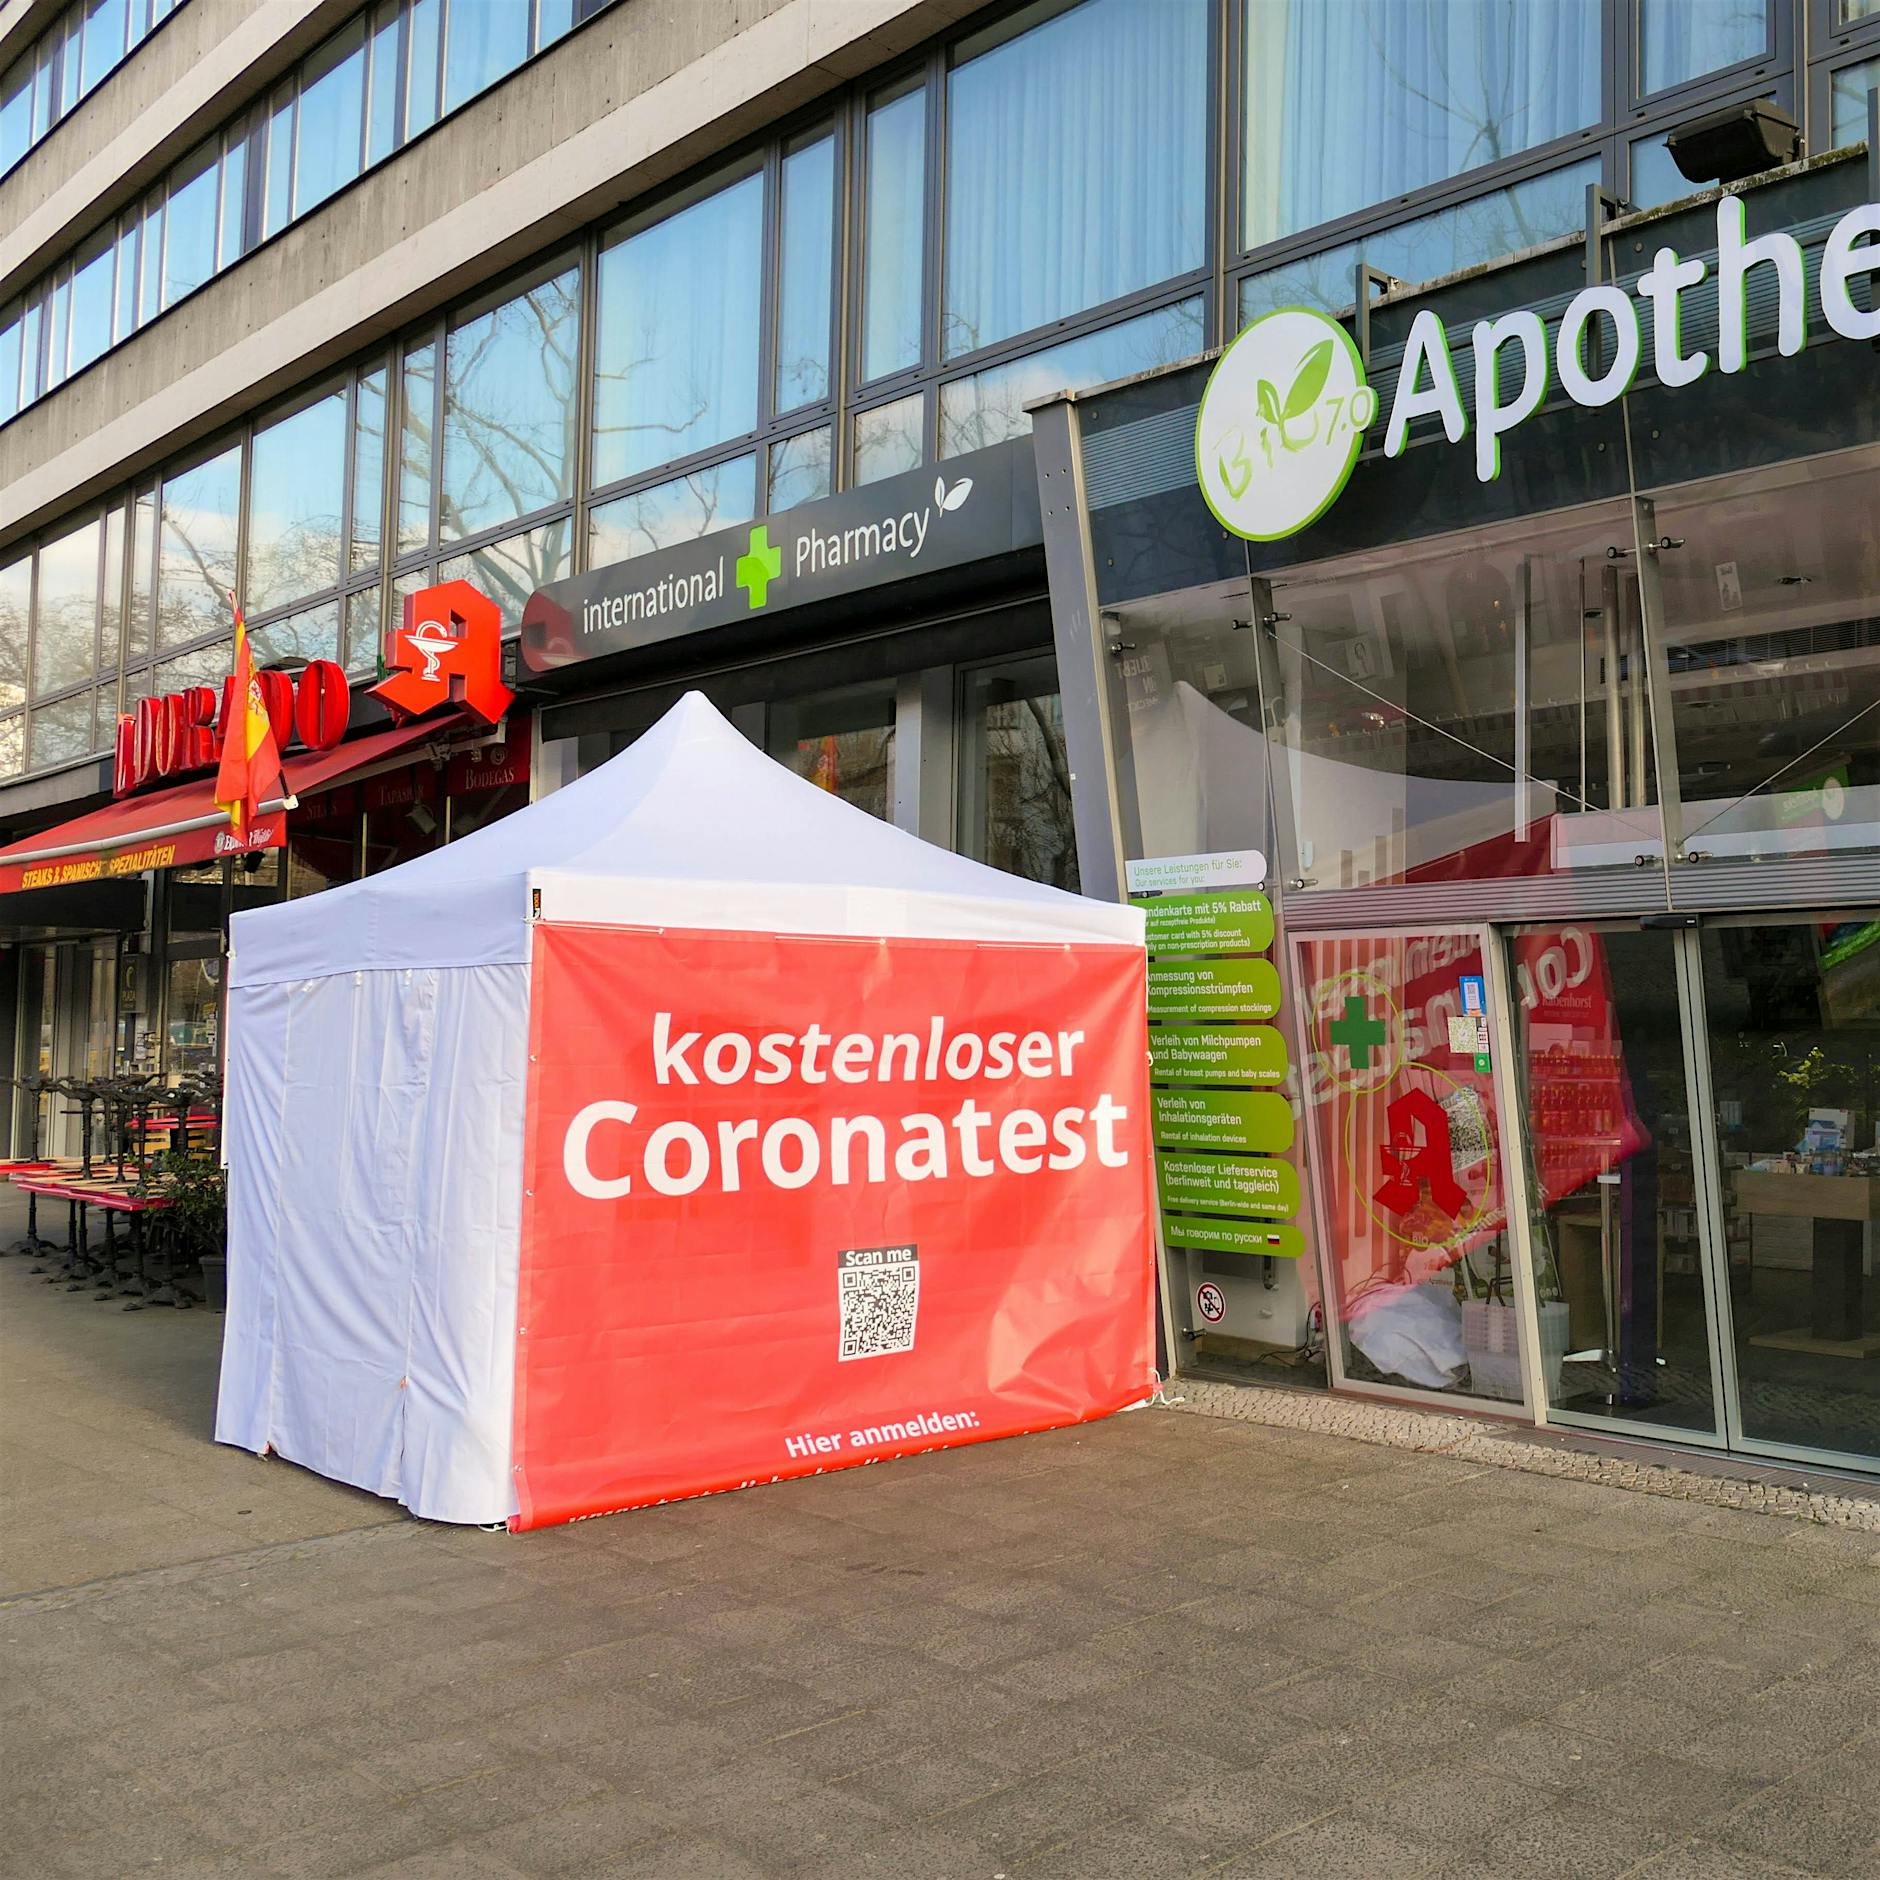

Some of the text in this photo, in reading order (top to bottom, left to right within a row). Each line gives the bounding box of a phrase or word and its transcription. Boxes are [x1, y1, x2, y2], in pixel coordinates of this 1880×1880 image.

[583, 507, 929, 634] international Pharmacy
[22, 844, 177, 889] STEAKS & SPANISCH SPEZIALITÄTEN
[1134, 858, 1242, 877] Unsere Leistungen für Sie:
[1150, 877, 1177, 886] services
[1179, 876, 1189, 884] for
[1146, 899, 1262, 918] ndenkarte mit 5% Rabatt
[1171, 930, 1184, 940] card
[1185, 929, 1200, 939] with
[1201, 929, 1213, 938] 5%
[1214, 927, 1242, 938] discount
[1219, 937, 1251, 949] products)
[1197, 971, 1214, 981] von
[1190, 1003, 1197, 1013] of
[1240, 1002, 1272, 1014] stockings
[652, 1011, 1085, 1086] kostenloser
[1150, 1034, 1262, 1049] Verleih von Milchpumpen
[1153, 1048, 1228, 1063] und Babywaagen
[1175, 1067, 1182, 1077] of
[1183, 1068, 1203, 1077] breast
[1205, 1070, 1226, 1079] pumps
[1227, 1068, 1240, 1078] and
[1241, 1068, 1257, 1080] baby
[1258, 1069, 1280, 1079] scales
[1157, 1097, 1206, 1110] Verleih von
[1158, 1110, 1242, 1127] Inhalationsgeräten
[1182, 1131, 1189, 1140] of
[1222, 1133, 1247, 1144] devices
[563, 1092, 1129, 1201] Coronatest
[1164, 1160, 1278, 1179] Kostenloser Lieferservice
[1165, 1173, 1280, 1194] (berlinweit und taggleich)
[1170, 1225, 1185, 1237] Мы
[1186, 1228, 1221, 1241] говорим
[1222, 1231, 1233, 1241] по
[845, 1247, 912, 1267] Scan me
[785, 1410, 980, 1459] Hier anmelden:
